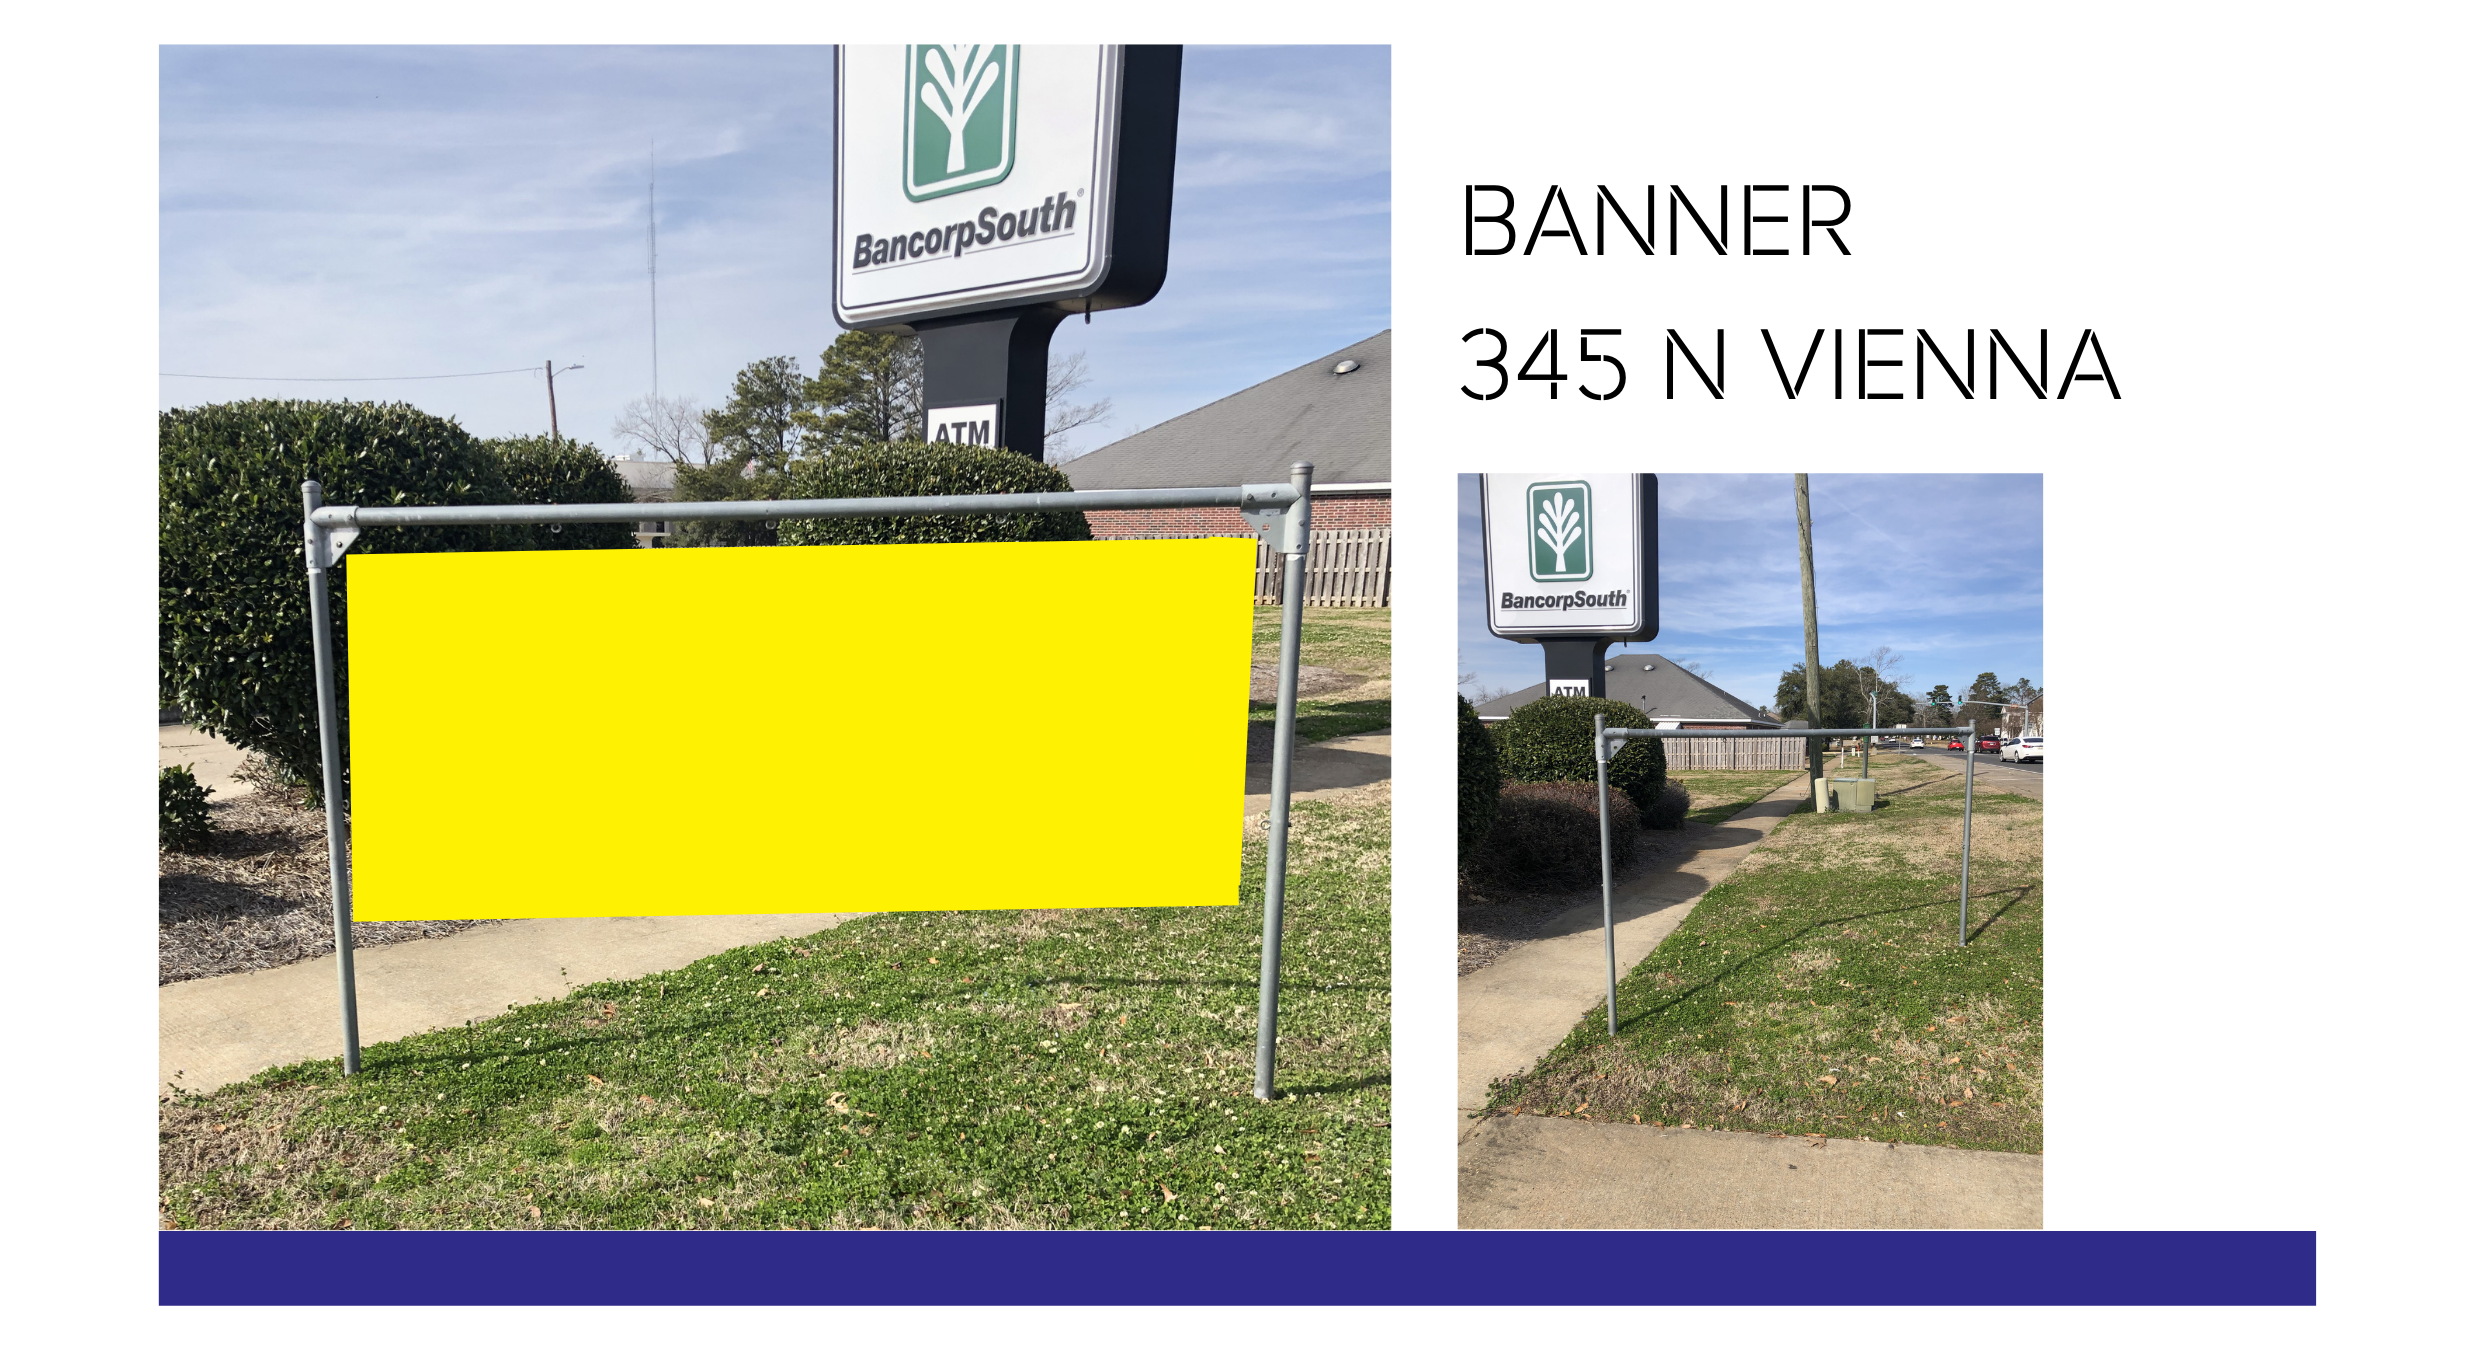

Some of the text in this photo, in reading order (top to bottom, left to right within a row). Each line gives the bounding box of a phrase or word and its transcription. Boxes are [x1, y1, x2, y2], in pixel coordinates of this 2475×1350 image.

[852, 191, 1077, 270] BancorpSouth
[935, 420, 990, 447] ATM
[1501, 589, 1627, 611] BancorpSouth
[1554, 686, 1586, 697] ATM
